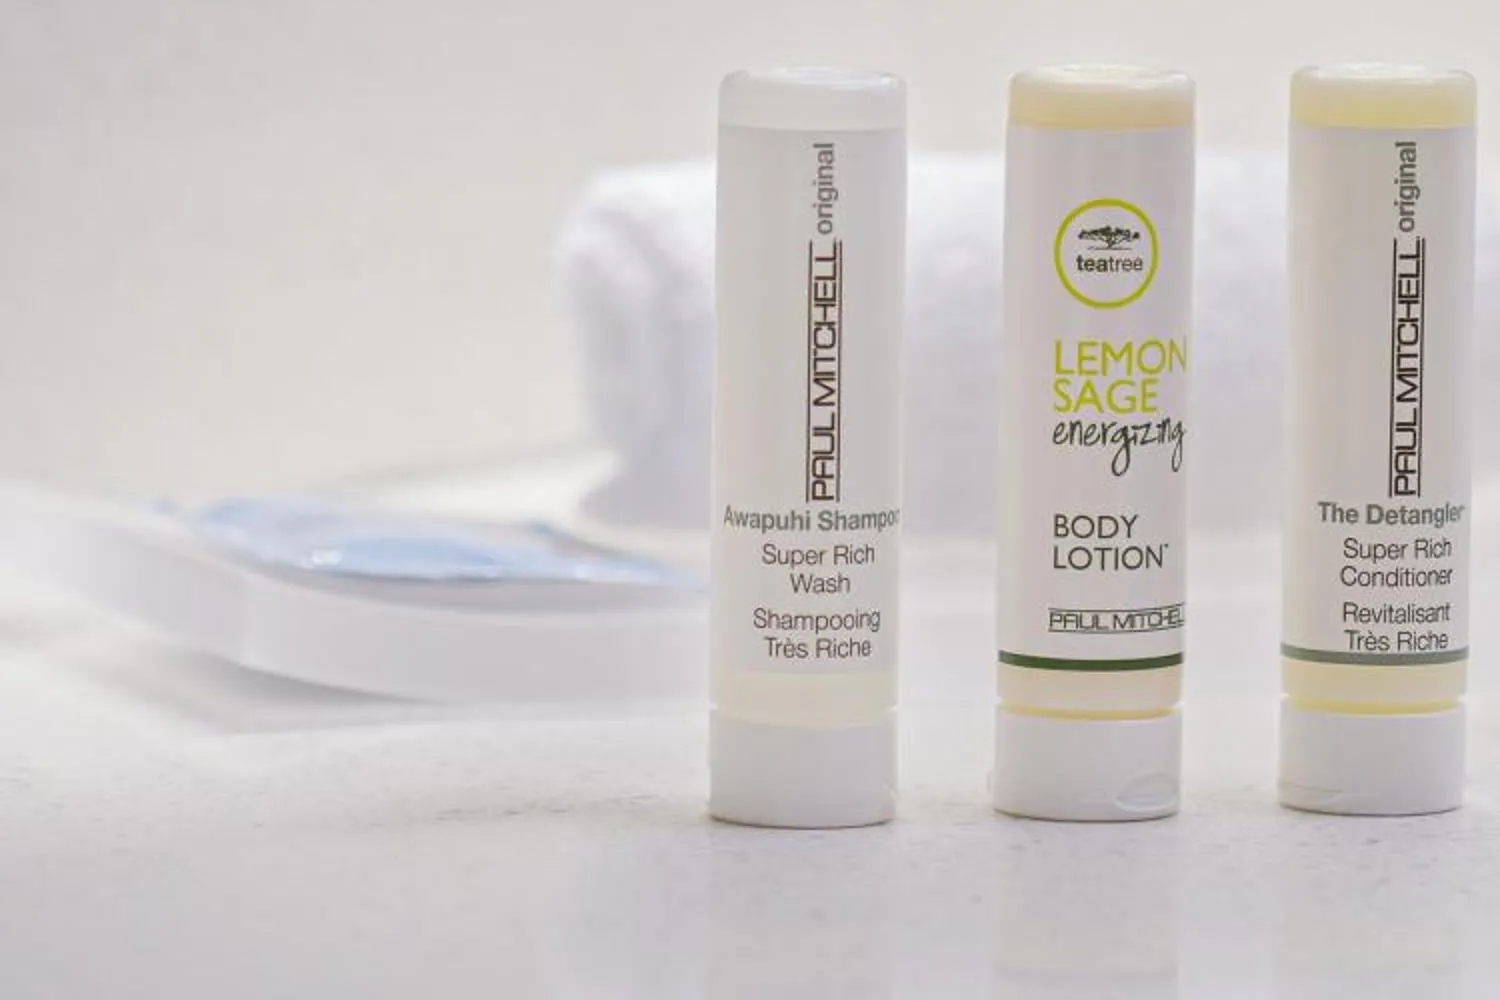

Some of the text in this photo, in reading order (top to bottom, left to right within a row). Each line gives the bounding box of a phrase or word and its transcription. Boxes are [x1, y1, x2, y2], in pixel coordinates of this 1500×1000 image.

[812, 143, 839, 235] original
[1394, 141, 1421, 233] original
[1076, 254, 1144, 273] teatree
[811, 236, 837, 501] PAUL MITCHELL
[1054, 336, 1187, 377] LEMON
[1394, 235, 1420, 496] PAUL MITCHELL
[1053, 377, 1160, 414] SAGE
[1052, 416, 1187, 477] energizing
[723, 504, 811, 533] Awapuhi
[1053, 513, 1139, 539] BODY
[1318, 502, 1465, 528] The Detangler
[761, 543, 876, 568] Super Rich
[1053, 543, 1163, 571] LOTION
[1343, 537, 1452, 563] Super Rich
[789, 572, 852, 594] Wash
[1340, 565, 1453, 588] Conditioner
[752, 607, 881, 634] Shampooing
[1049, 611, 1109, 630] PAUL
[1342, 601, 1451, 625] Revitalisant
[764, 636, 872, 659] Très Riche
[1344, 629, 1449, 651] Très Riche
